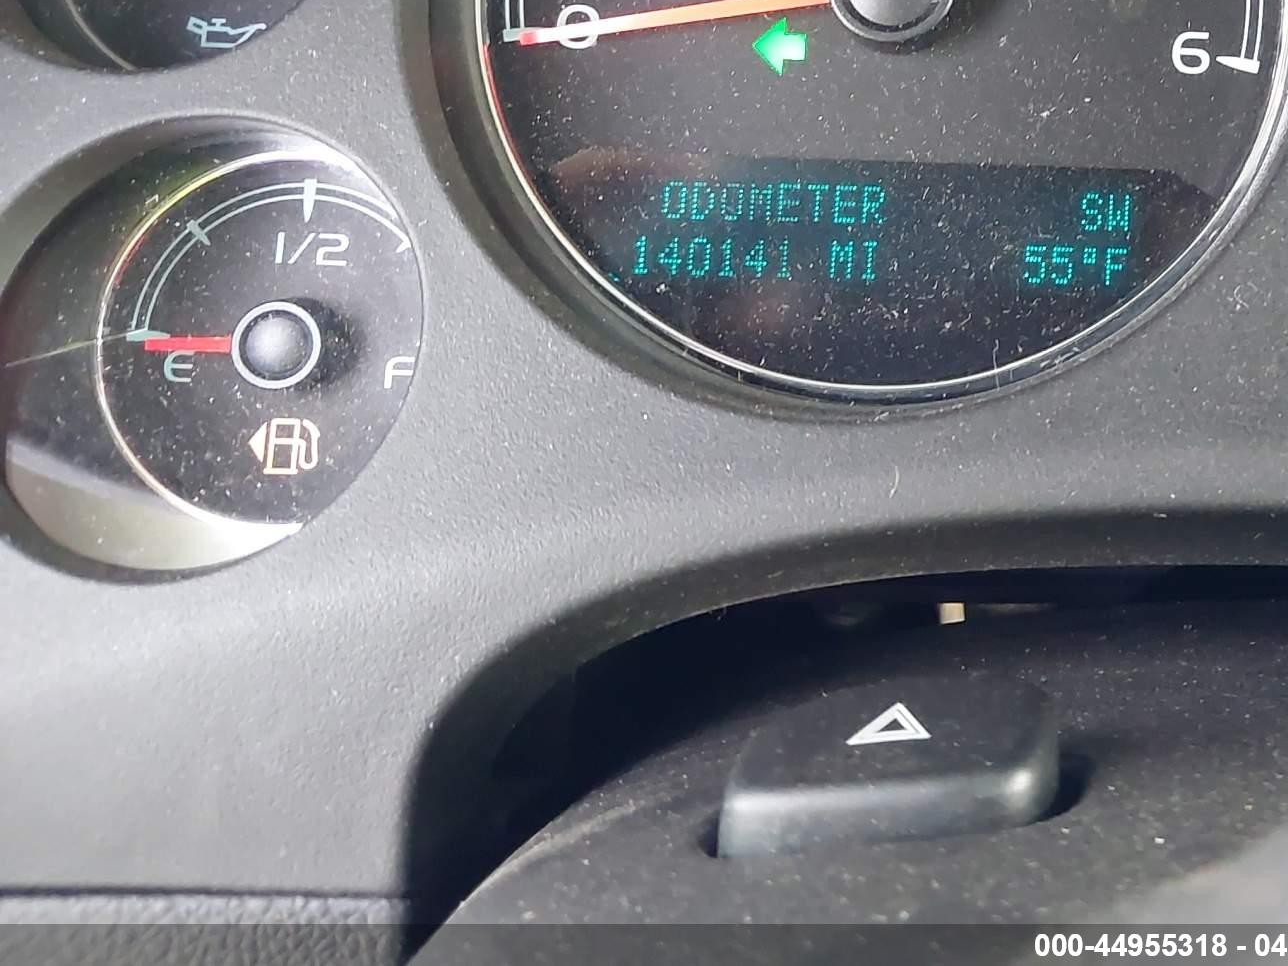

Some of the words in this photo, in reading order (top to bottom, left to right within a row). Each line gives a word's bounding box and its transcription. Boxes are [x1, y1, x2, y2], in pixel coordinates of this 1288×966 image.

[556, 3, 600, 50] 0
[1172, 30, 1210, 75] 6
[661, 179, 887, 227] ODOMETER
[1079, 192, 1132, 234] SW
[273, 230, 350, 267] 1/2
[631, 235, 791, 279] 140141
[828, 239, 878, 281] MI
[1023, 244, 1129, 287] 55°F
[163, 350, 195, 383] E
[384, 355, 416, 389] F
